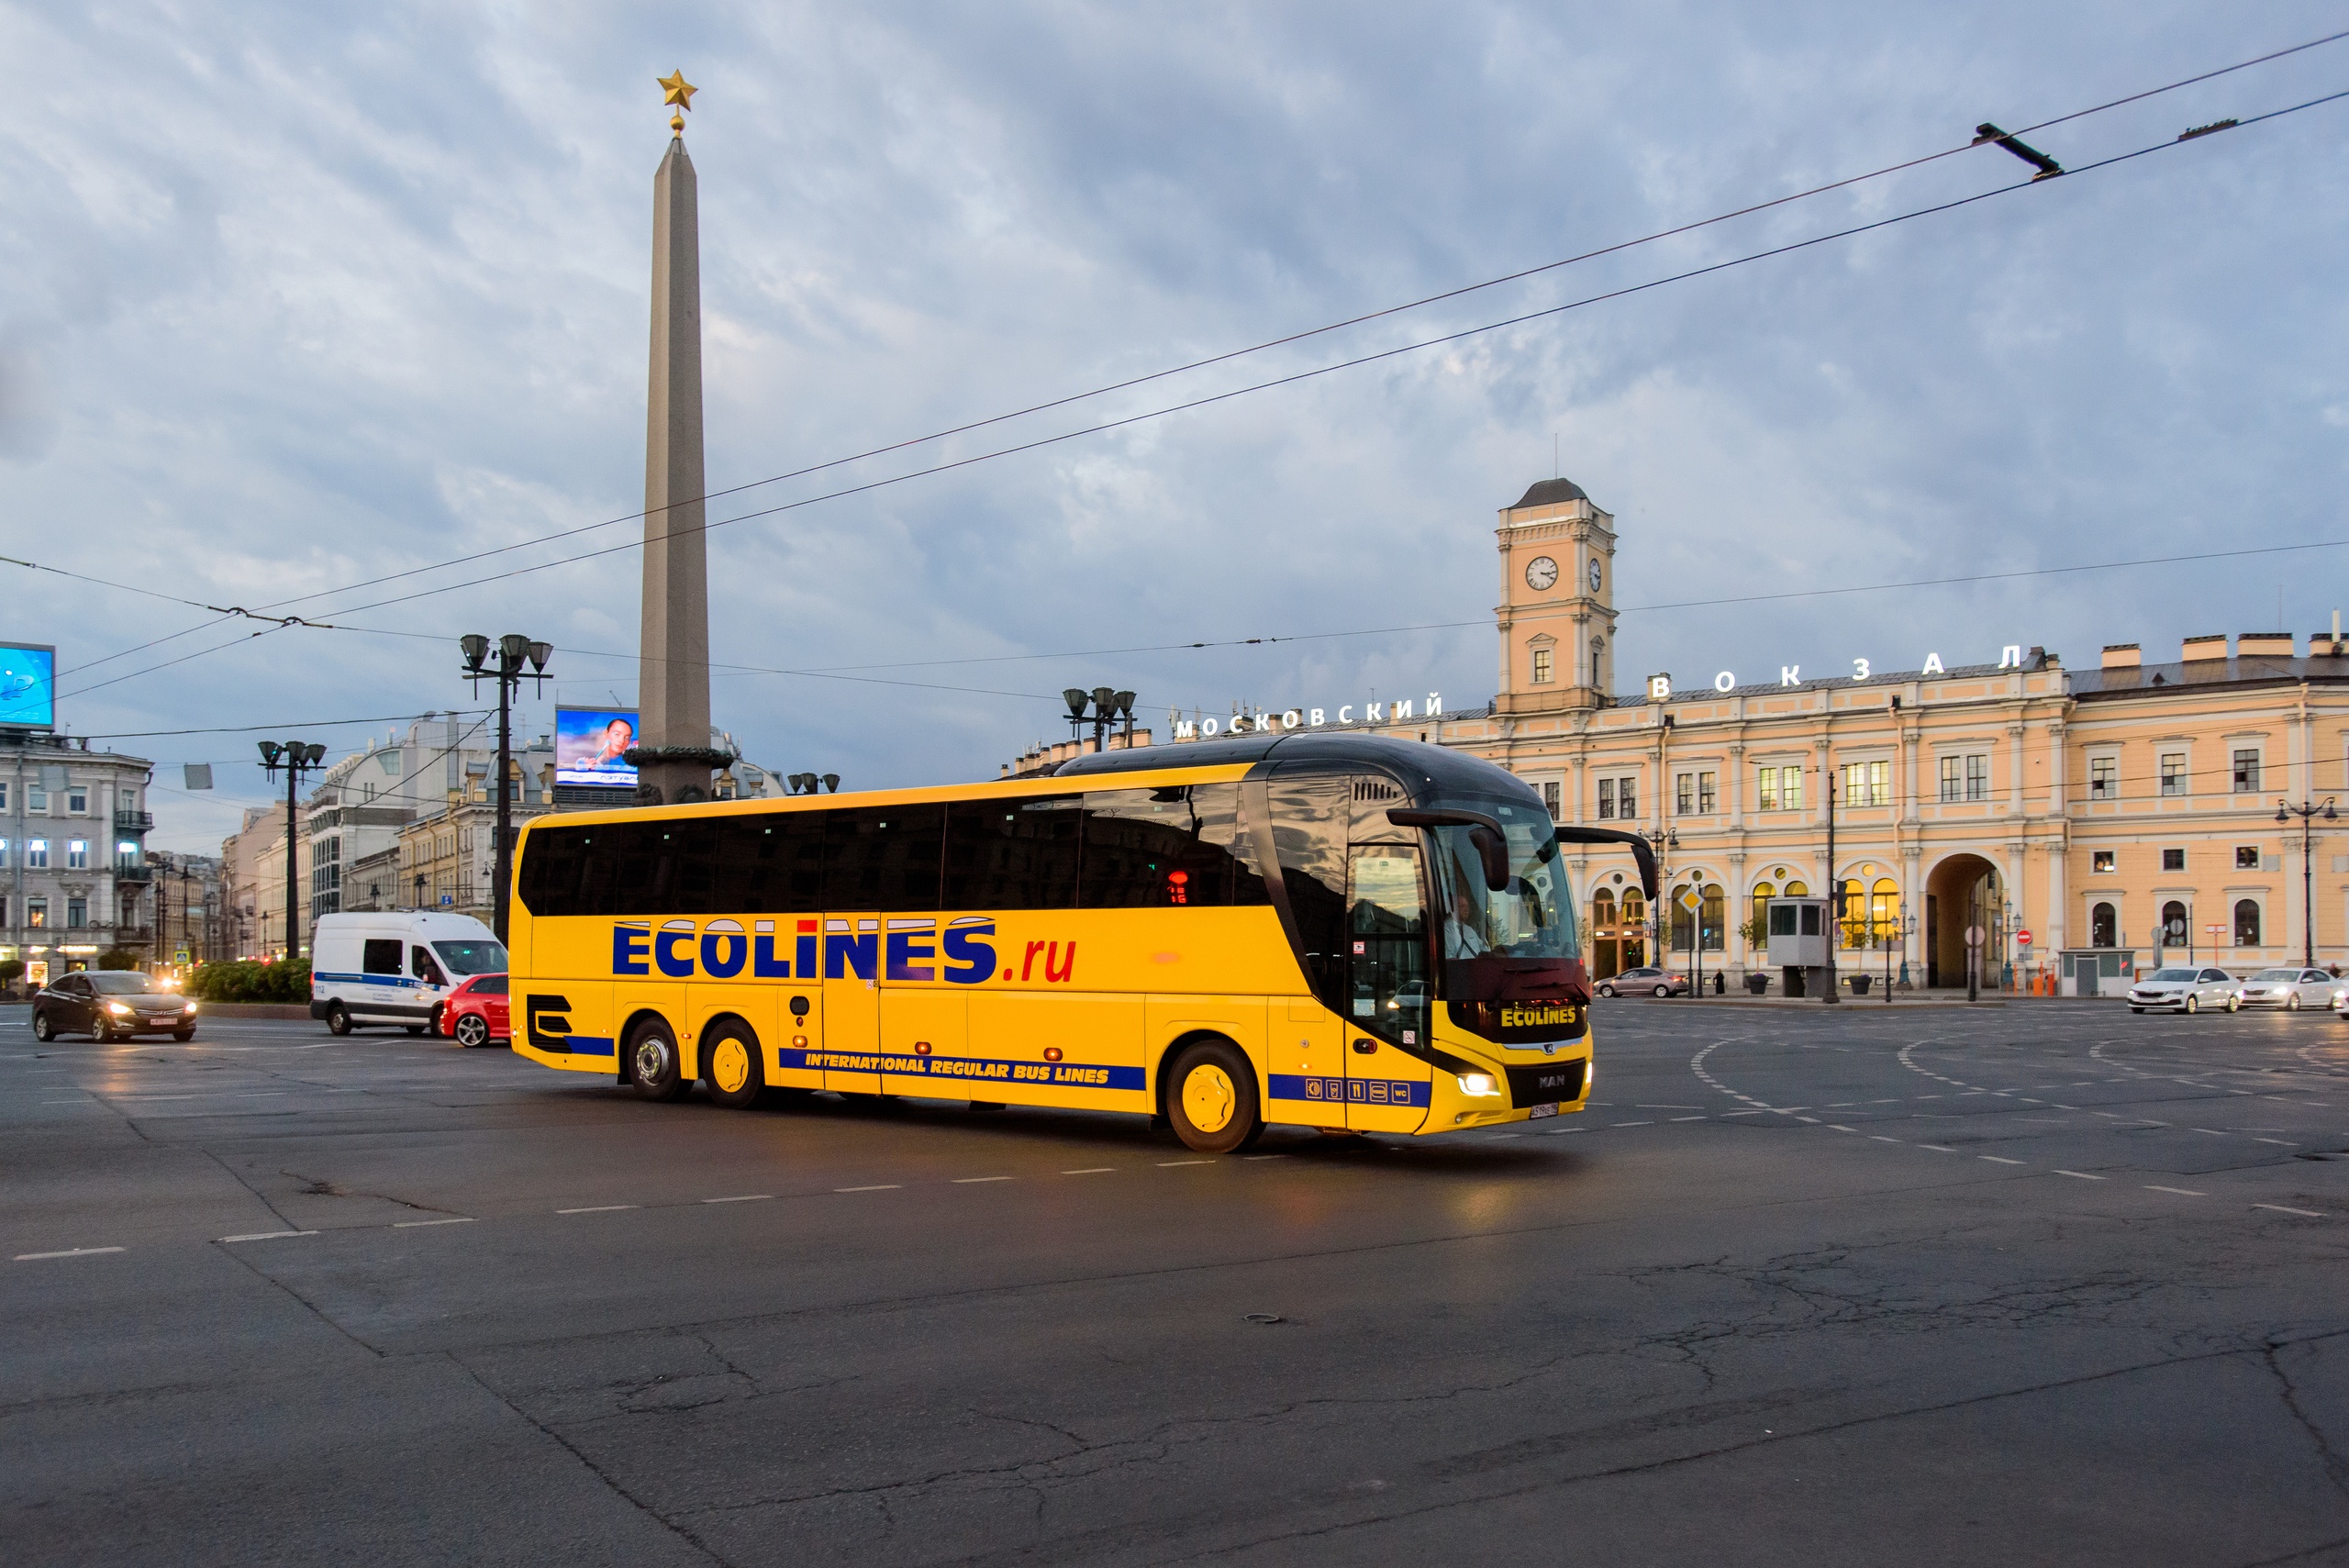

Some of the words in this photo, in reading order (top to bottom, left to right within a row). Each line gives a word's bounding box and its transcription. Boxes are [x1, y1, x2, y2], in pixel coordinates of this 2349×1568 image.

[1176, 692, 1442, 738] МОСКОВСКИЙ
[1652, 645, 2021, 698] ВОКЗАЛ
[316, 984, 325, 994] 112
[805, 1053, 926, 1072] INTERNATIONAL
[930, 1060, 1009, 1077] REGULAR
[1013, 1065, 1051, 1081] BUS
[1054, 1067, 1109, 1084] LINES
[1539, 1074, 1565, 1089] MAN
